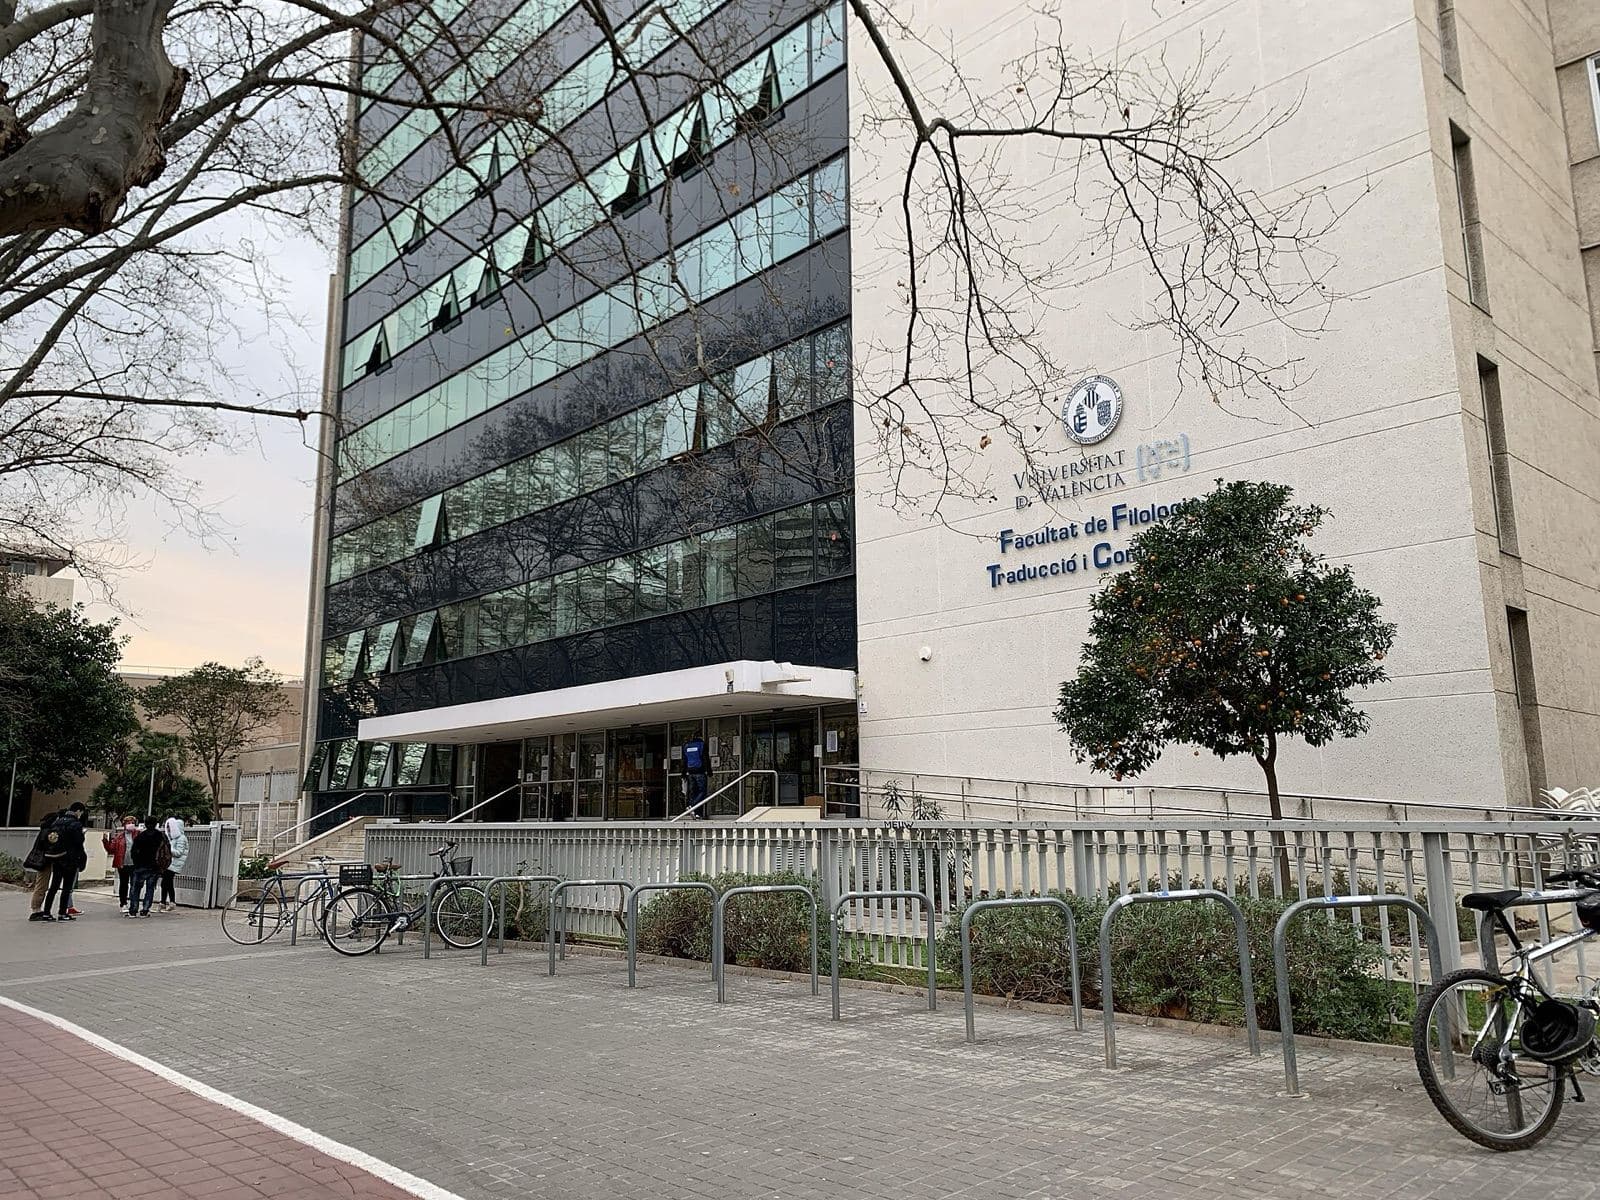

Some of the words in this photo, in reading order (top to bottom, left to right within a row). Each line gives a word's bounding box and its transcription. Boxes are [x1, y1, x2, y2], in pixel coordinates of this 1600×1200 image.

[1000, 522, 1079, 554] Facultat
[1084, 516, 1108, 536] de
[986, 553, 1078, 588] Traducció
[1082, 554, 1087, 570] i
